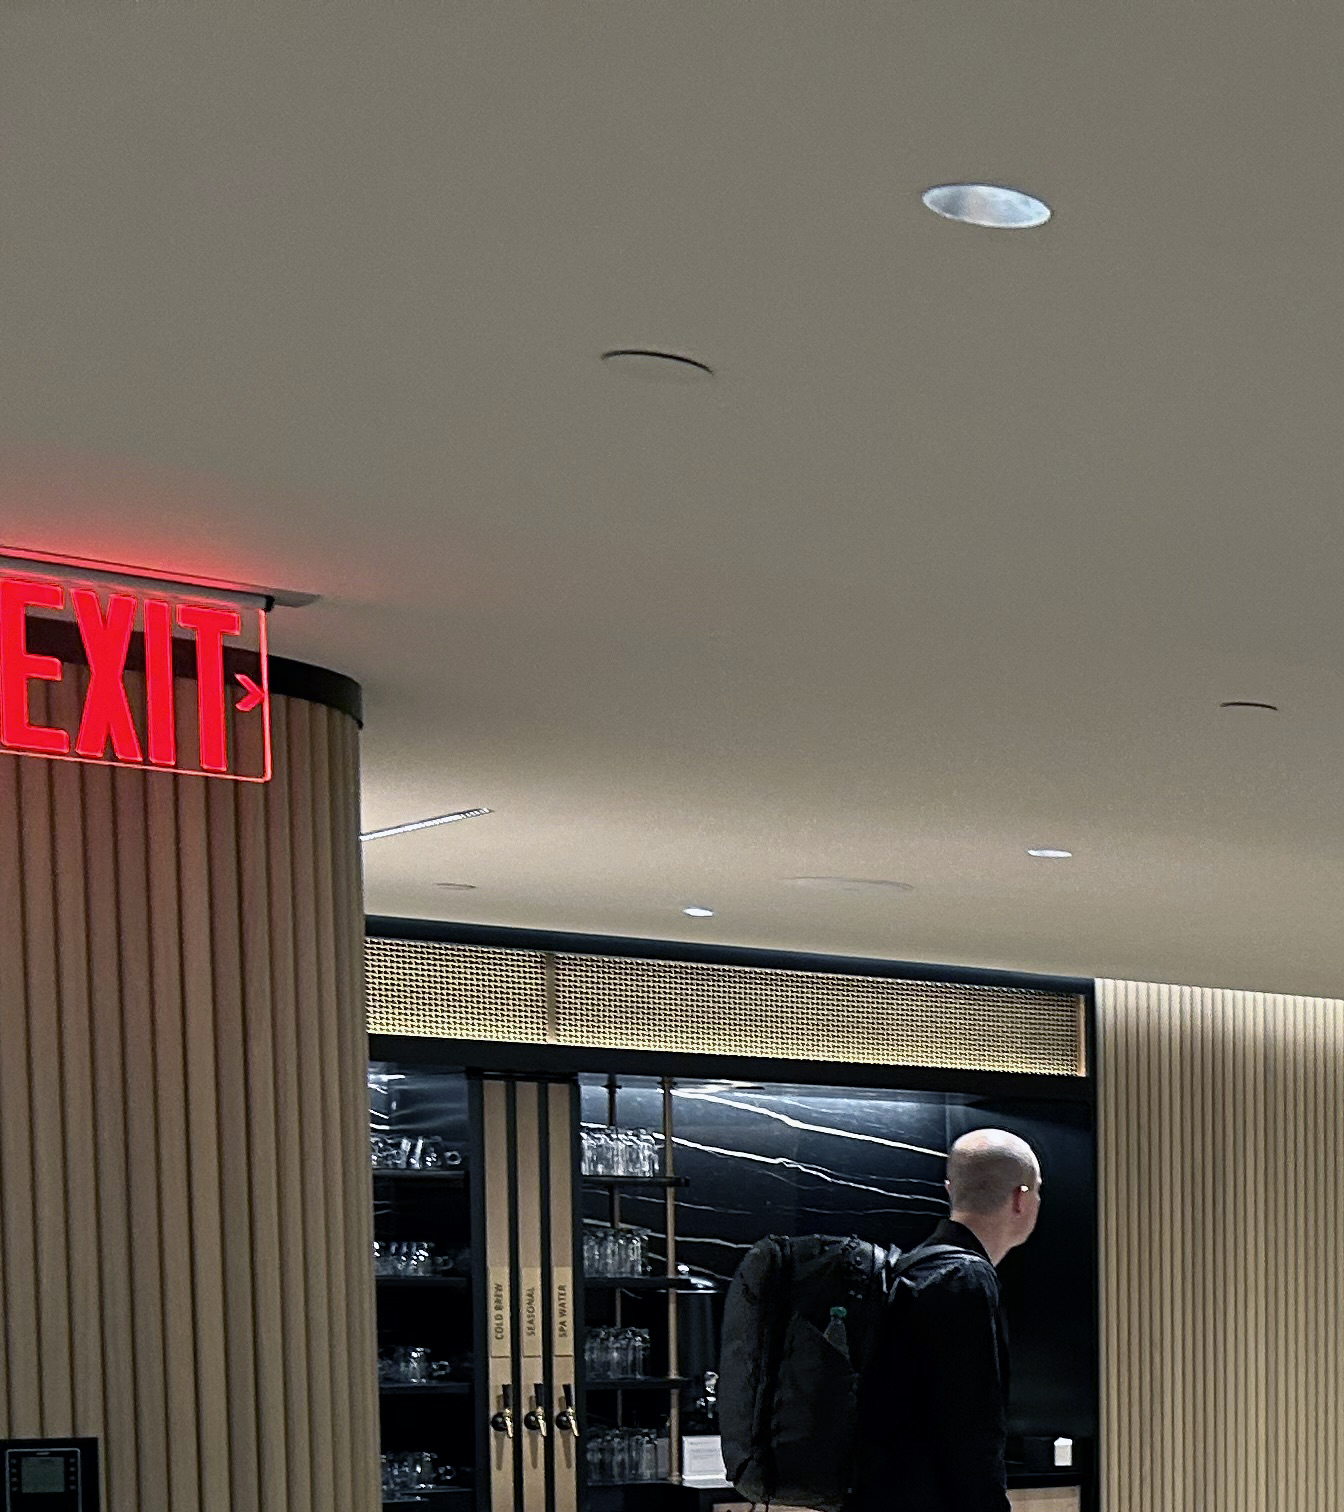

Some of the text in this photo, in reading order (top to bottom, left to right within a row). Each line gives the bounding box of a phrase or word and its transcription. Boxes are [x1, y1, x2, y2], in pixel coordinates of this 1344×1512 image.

[0, 577, 241, 772] EXIT
[494, 1283, 504, 1340] COLD BREW
[526, 1287, 535, 1336] SEASONAL
[558, 1284, 568, 1338] SPA WATER
